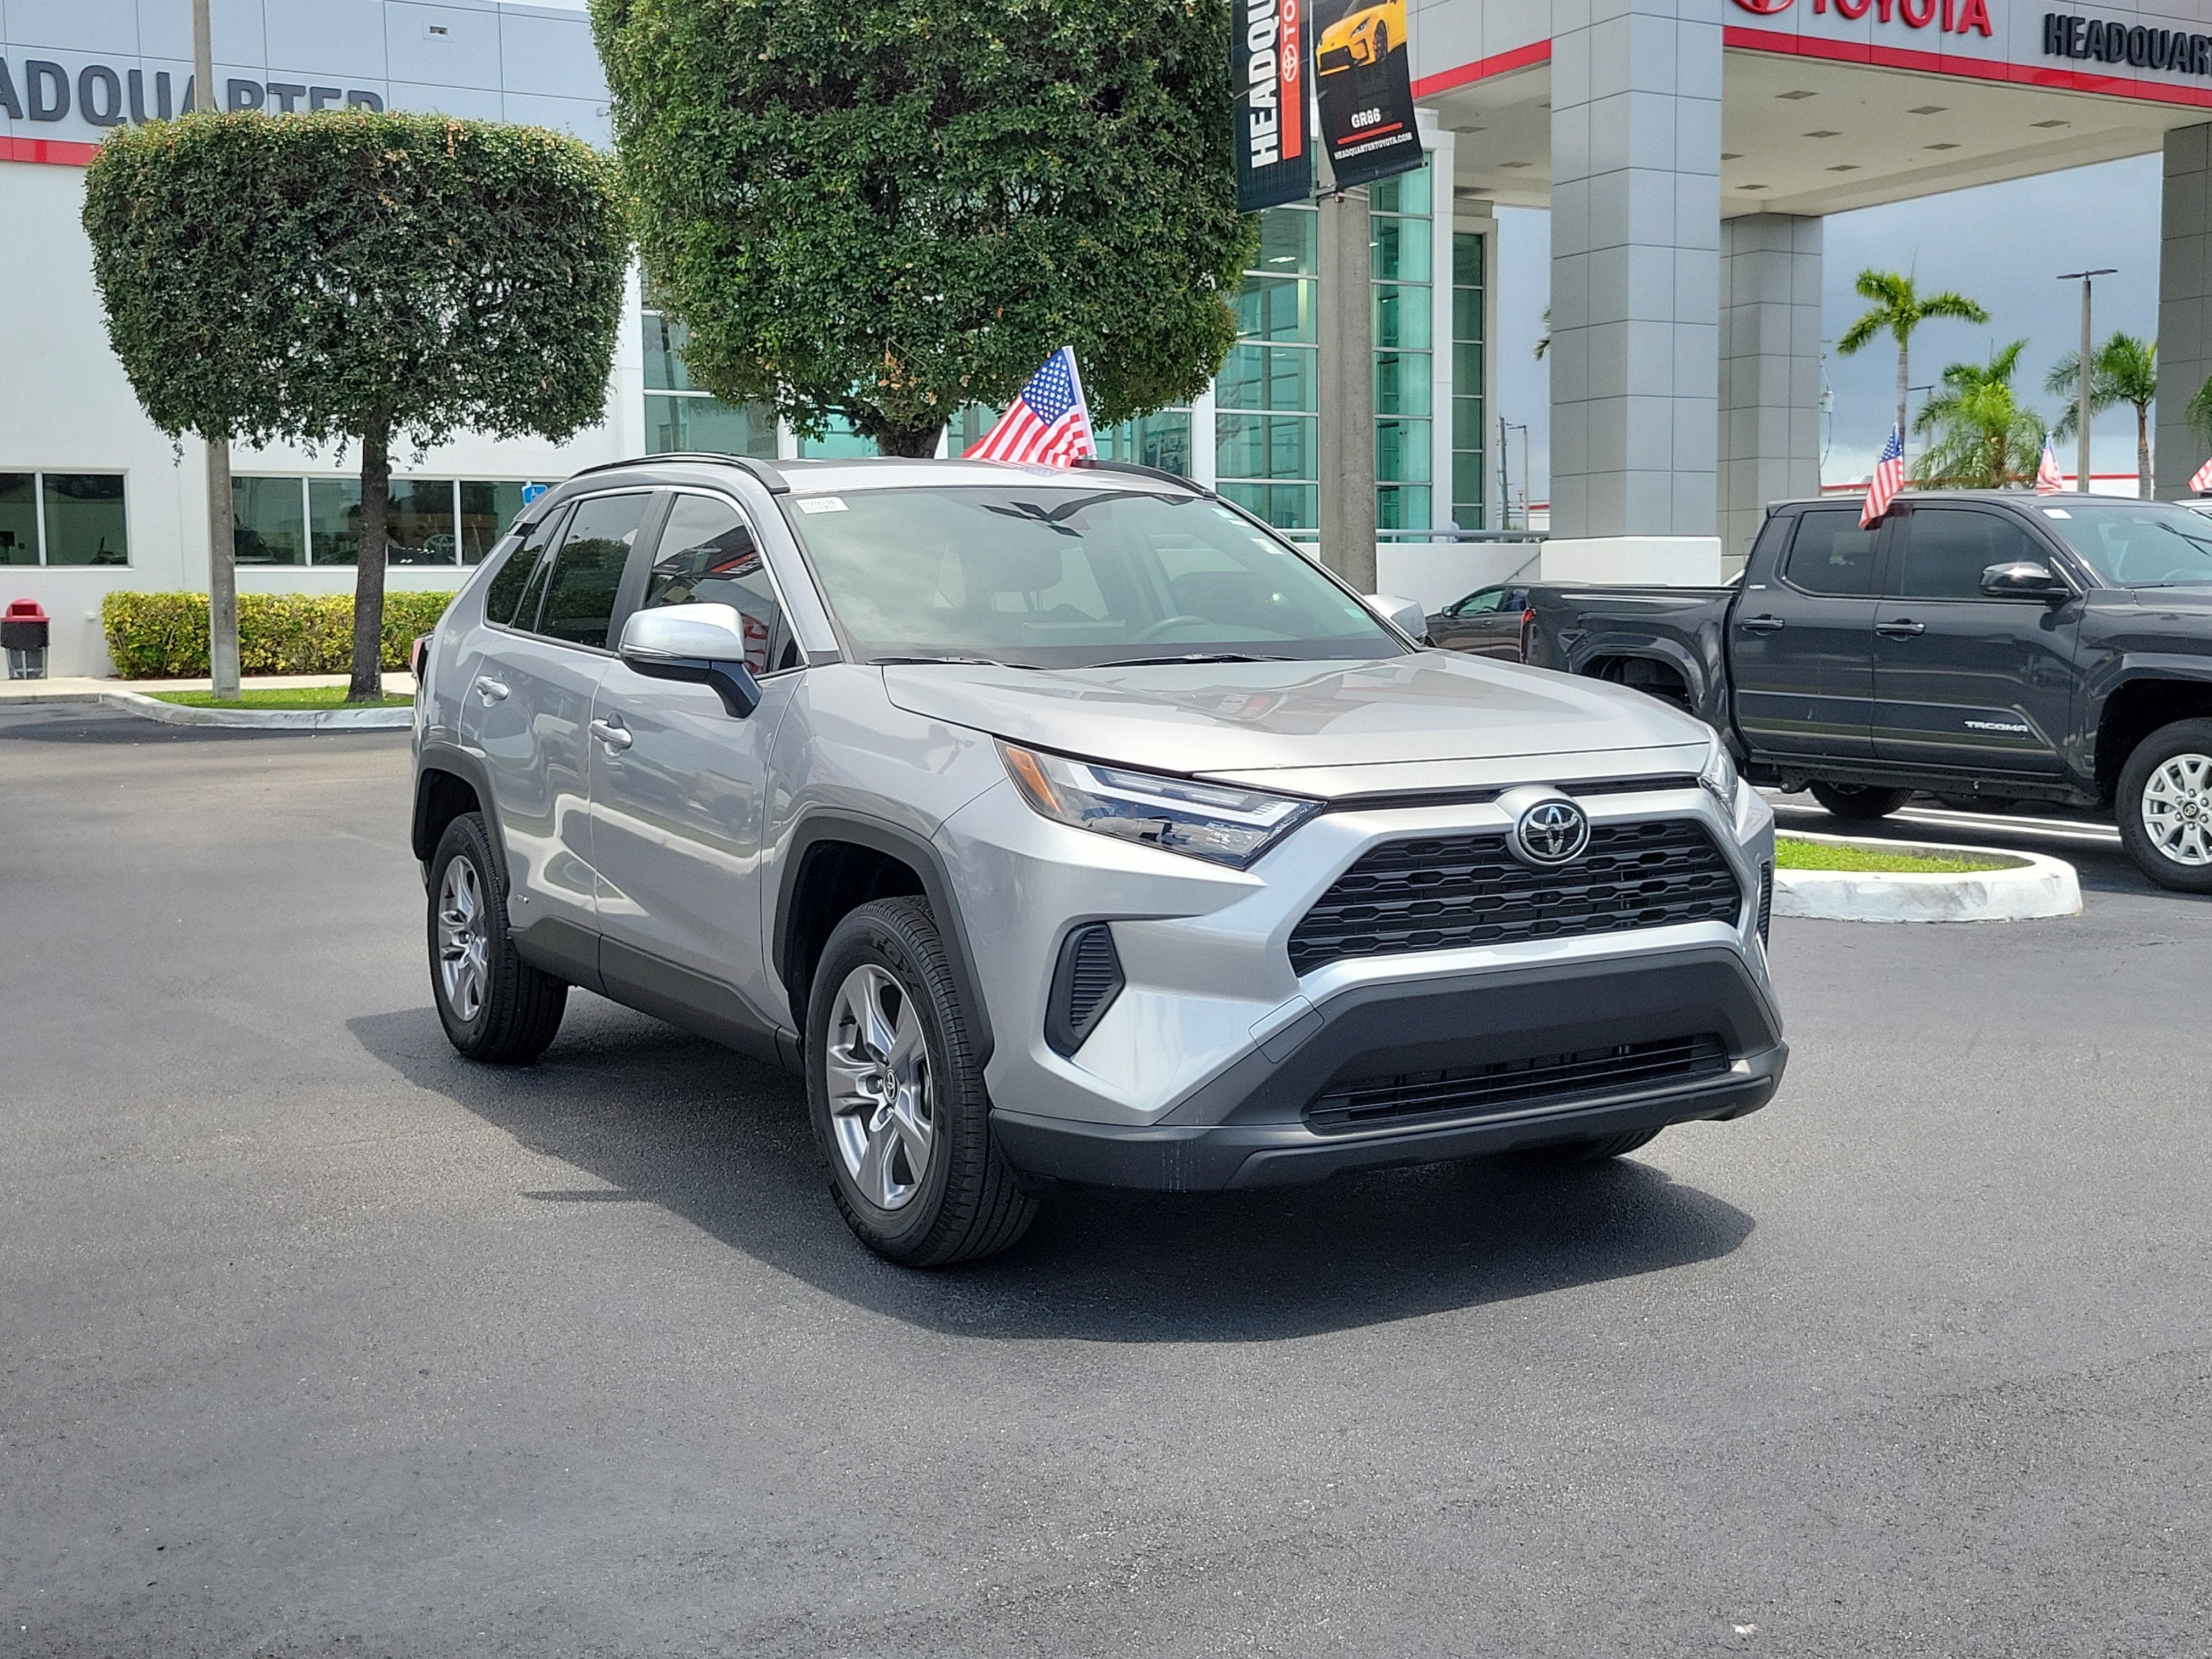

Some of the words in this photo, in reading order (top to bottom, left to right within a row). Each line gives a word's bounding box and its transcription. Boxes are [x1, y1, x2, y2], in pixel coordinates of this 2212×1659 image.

[1283, 0, 1295, 43] TO
[2044, 13, 2212, 76] HEADQUAR
[1351, 108, 1381, 128] GR86
[1963, 720, 2028, 732] TACOMA
